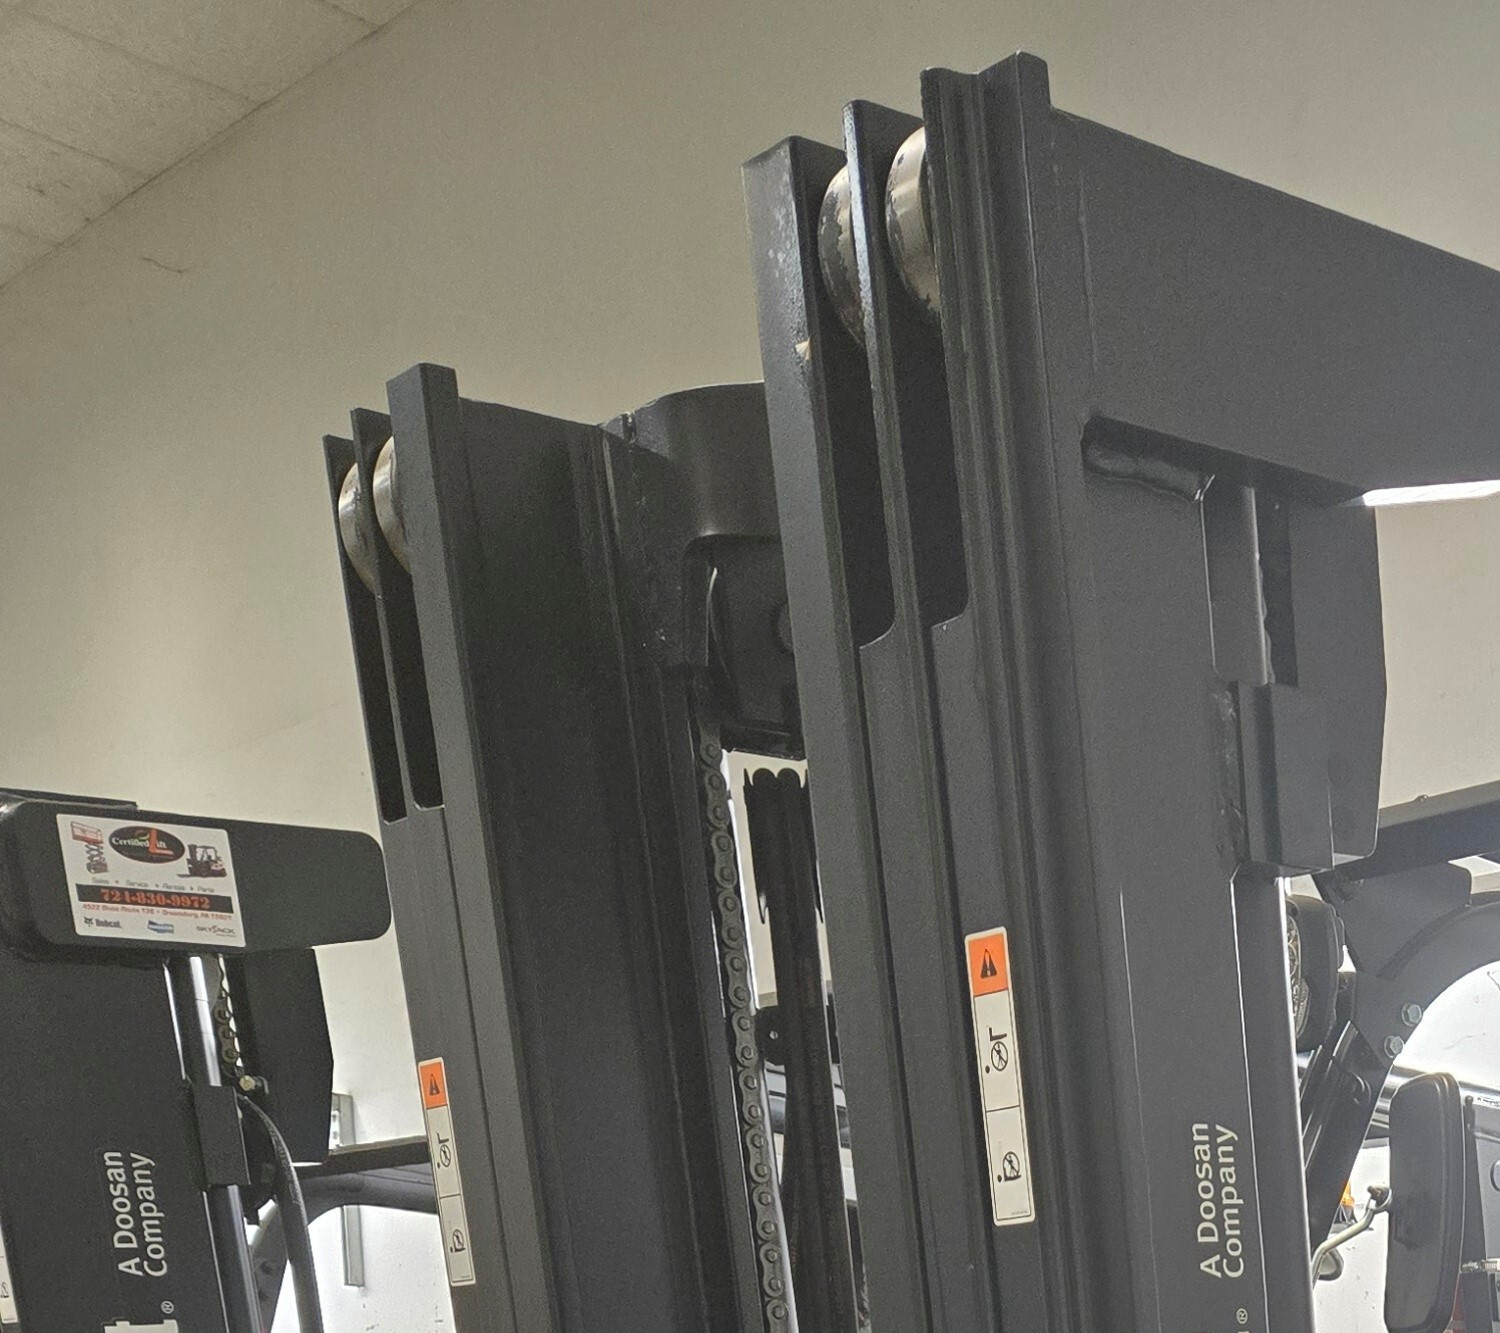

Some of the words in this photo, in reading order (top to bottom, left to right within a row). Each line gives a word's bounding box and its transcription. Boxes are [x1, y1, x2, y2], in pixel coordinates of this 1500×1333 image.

[103, 1151, 139, 1249] Doosan
[129, 1152, 168, 1277] Company
[1191, 1123, 1219, 1243] Doosan
[1215, 1124, 1245, 1278] Company
[117, 1257, 144, 1277] A
[1199, 1253, 1222, 1279] A
